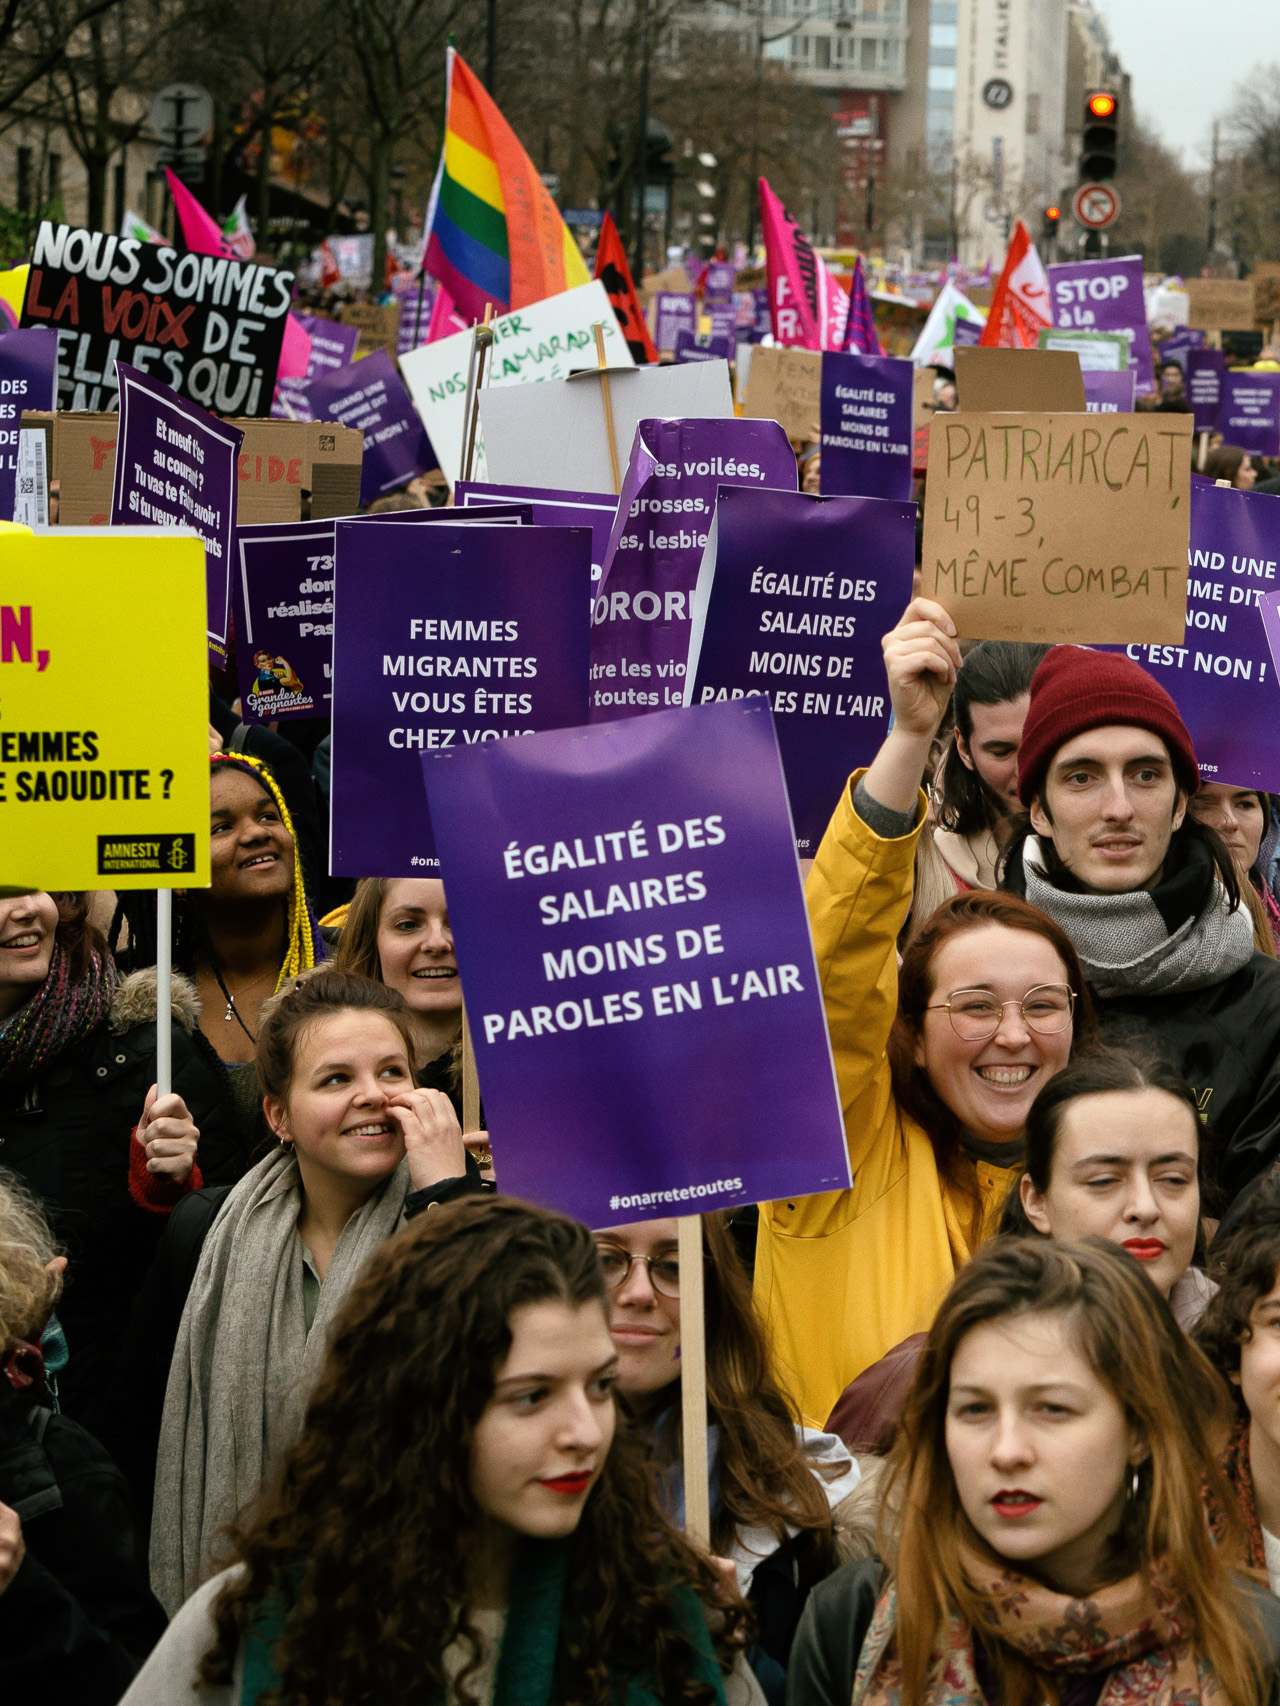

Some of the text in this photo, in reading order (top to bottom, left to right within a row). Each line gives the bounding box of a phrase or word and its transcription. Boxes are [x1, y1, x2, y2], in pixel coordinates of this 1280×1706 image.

[33, 220, 295, 319] NOUS SOMMES
[1055, 275, 1129, 304] STOP
[26, 270, 80, 325] LA
[203, 313, 266, 364] DE
[1058, 305, 1095, 327] à la
[1, 380, 28, 394] DES
[428, 372, 467, 402] NOS
[834, 384, 896, 404] ÉGALITÉ DES
[841, 403, 888, 420] SALAIRES
[156, 417, 168, 441] Et
[168, 427, 193, 456] meuf
[822, 434, 866, 451] PAROLES
[865, 441, 882, 452] EN
[840, 421, 890, 438] MOINS DE
[153, 449, 198, 489] au courant
[684, 456, 766, 481] voilées,
[129, 490, 152, 519] Si tu
[134, 463, 147, 488] Tu
[147, 474, 164, 497] vas
[165, 480, 178, 502] te
[193, 502, 215, 527] avoir
[629, 496, 711, 518] grosses,
[933, 548, 1027, 598] MÊME
[1042, 557, 1182, 600] COMBAT
[1231, 554, 1278, 580] UNE
[749, 566, 878, 603] ÉGALITÉ DES
[1229, 585, 1266, 608] DIT
[409, 619, 519, 642] FEMMES
[758, 609, 857, 639] SALAIRES
[382, 655, 538, 679] MIGRANTES
[621, 658, 652, 679] les
[748, 650, 855, 679] MOINS DE
[1126, 642, 1252, 680] C'EST NON
[246, 687, 296, 711] Grandes
[257, 692, 314, 718] gagnantes
[392, 688, 534, 715] VOUS ÊTES
[593, 686, 659, 708] toutes
[802, 691, 885, 718] EN L'AIR
[388, 728, 456, 749] CHEZ
[15, 768, 175, 802] SAOUDITE ?
[103, 842, 161, 859] AMNESTY
[503, 815, 727, 880] ÉGALITÉ DES
[103, 859, 161, 870] INTERNATIONAL
[538, 870, 708, 927] SALAIRES
[541, 924, 725, 982] MOINS DE
[482, 963, 804, 1045] PAROLES EN L'AIR
[608, 1175, 743, 1211] #onarretetoutes
